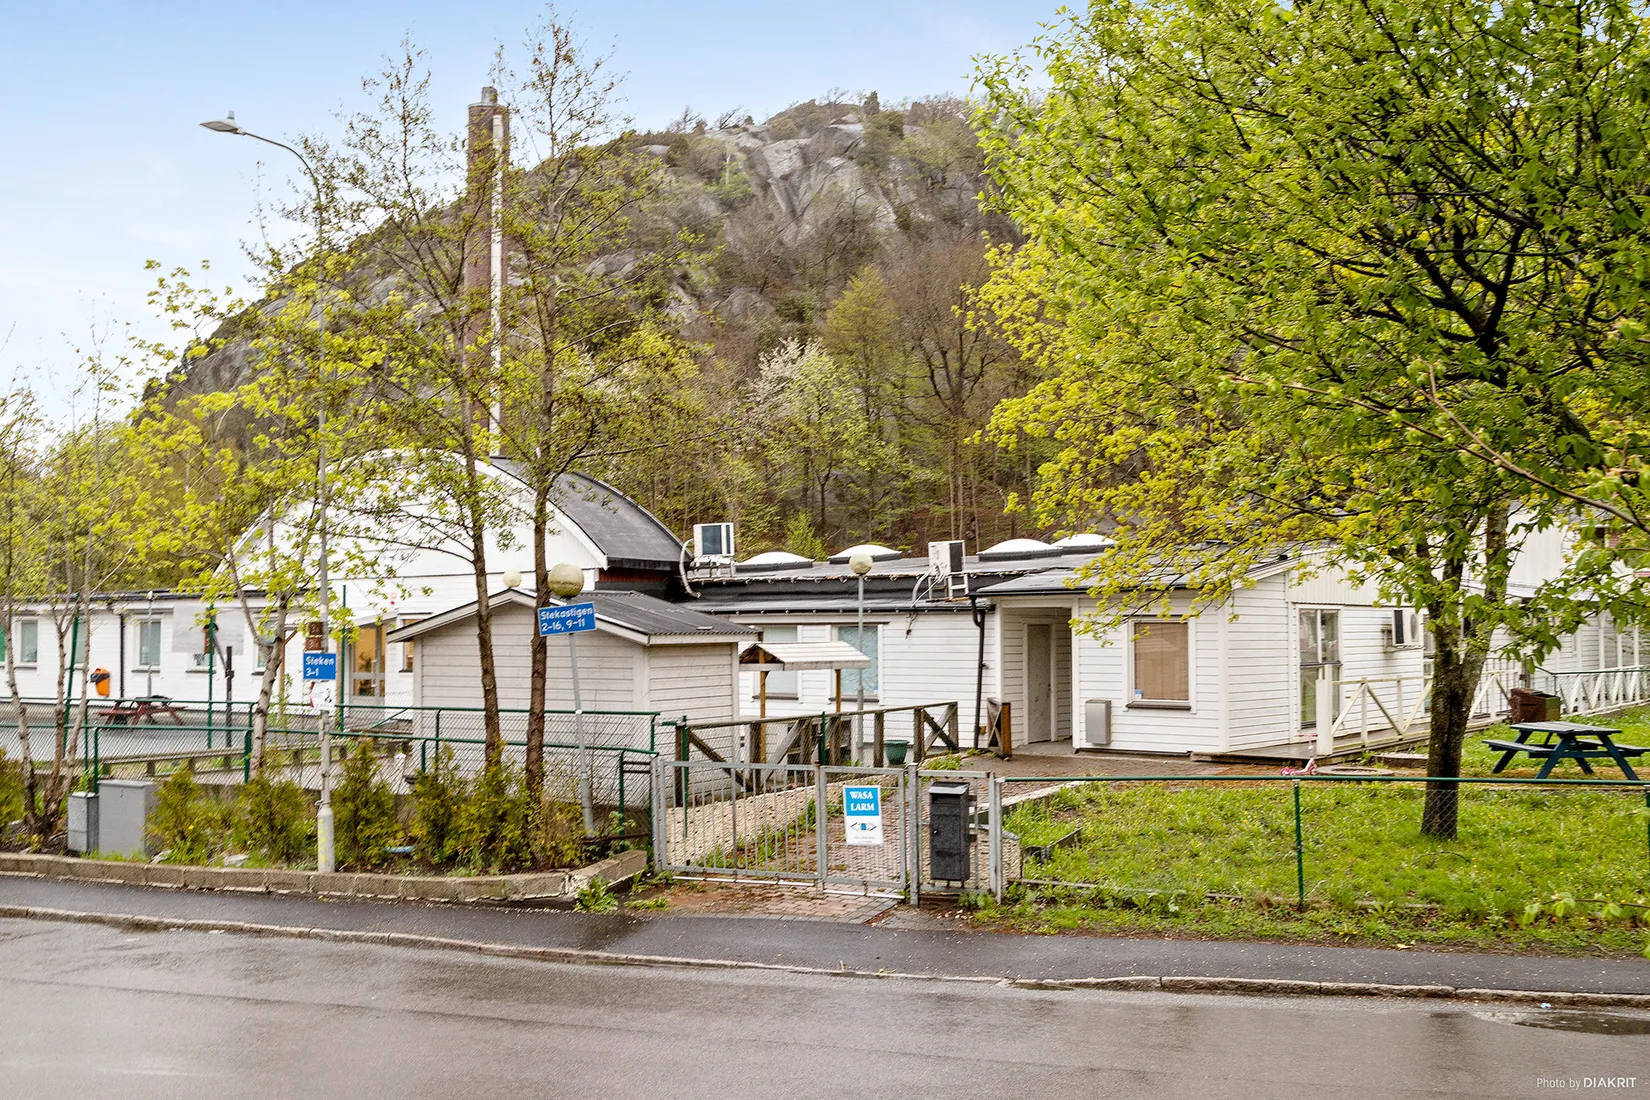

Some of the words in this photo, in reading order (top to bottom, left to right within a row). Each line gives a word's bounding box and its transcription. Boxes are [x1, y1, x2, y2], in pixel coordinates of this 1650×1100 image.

[566, 618, 586, 629] 9-11
[849, 790, 874, 800] WASA
[850, 803, 875, 812] LARM
